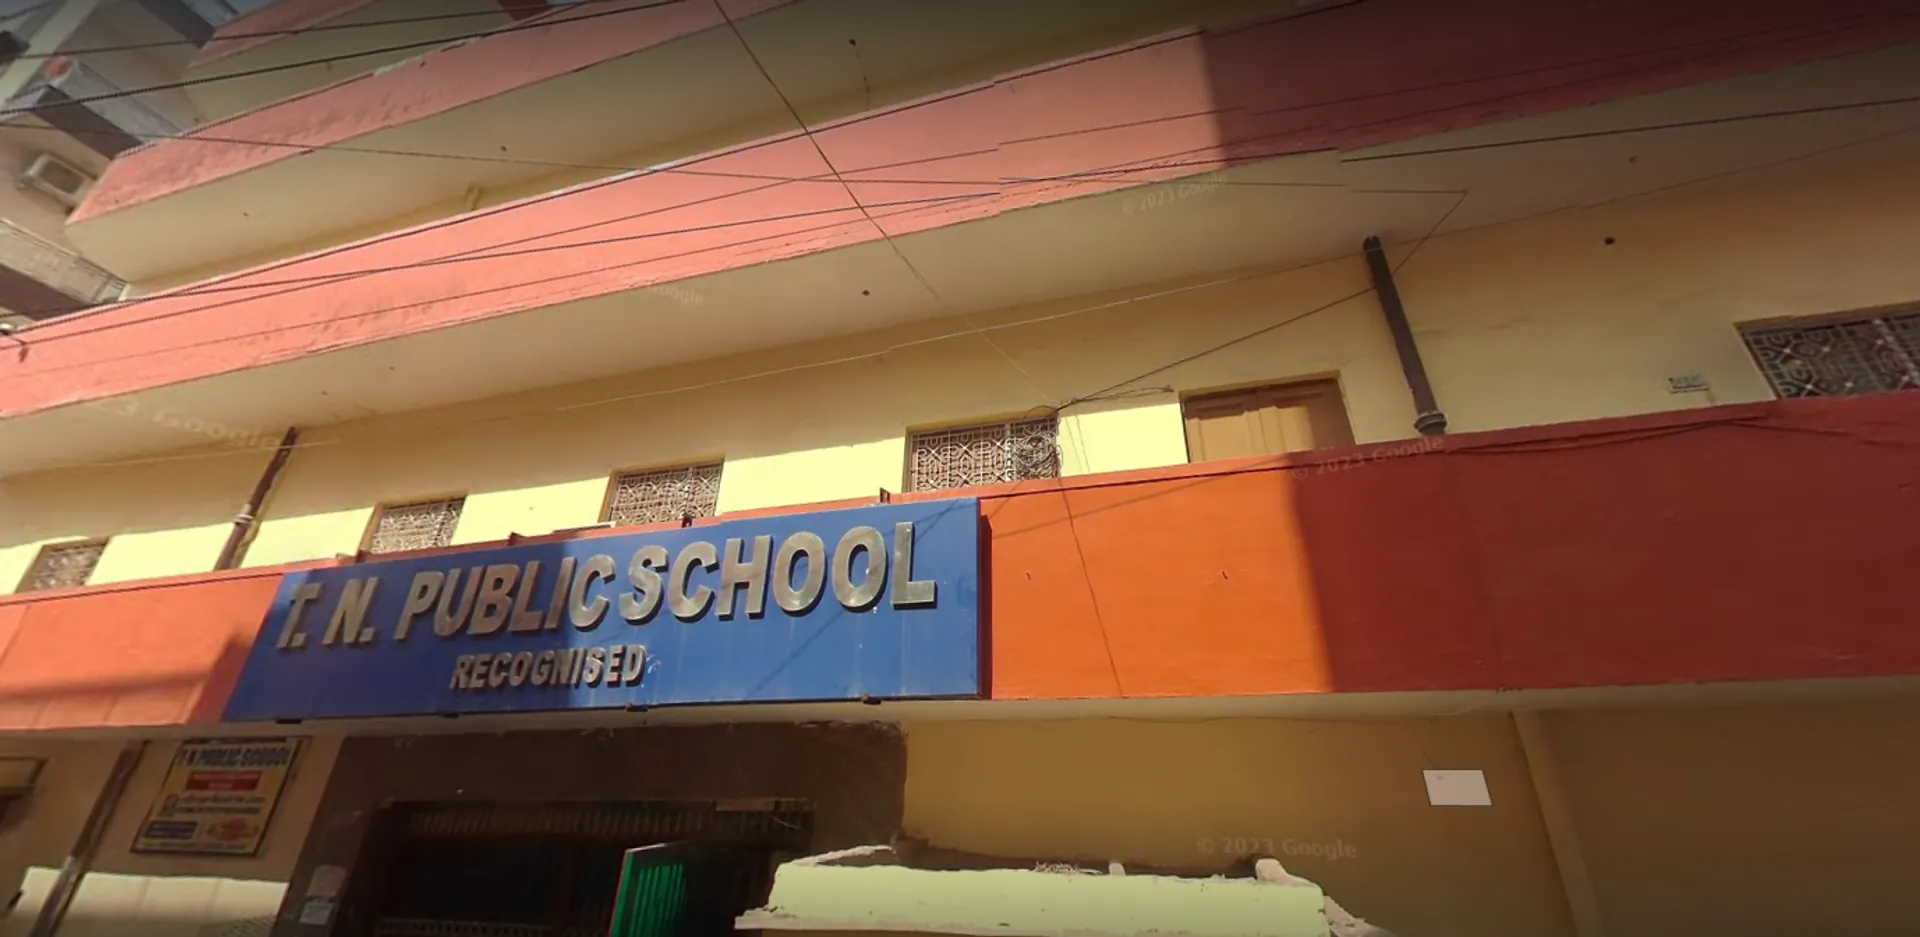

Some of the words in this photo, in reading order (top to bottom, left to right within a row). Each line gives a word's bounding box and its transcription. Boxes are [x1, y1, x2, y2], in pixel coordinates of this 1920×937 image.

[276, 581, 323, 649] T.
[322, 576, 379, 646] N.
[393, 553, 617, 641] PUBLIC
[619, 522, 937, 624] SCHOOL
[450, 644, 646, 690] RECOGNISED
